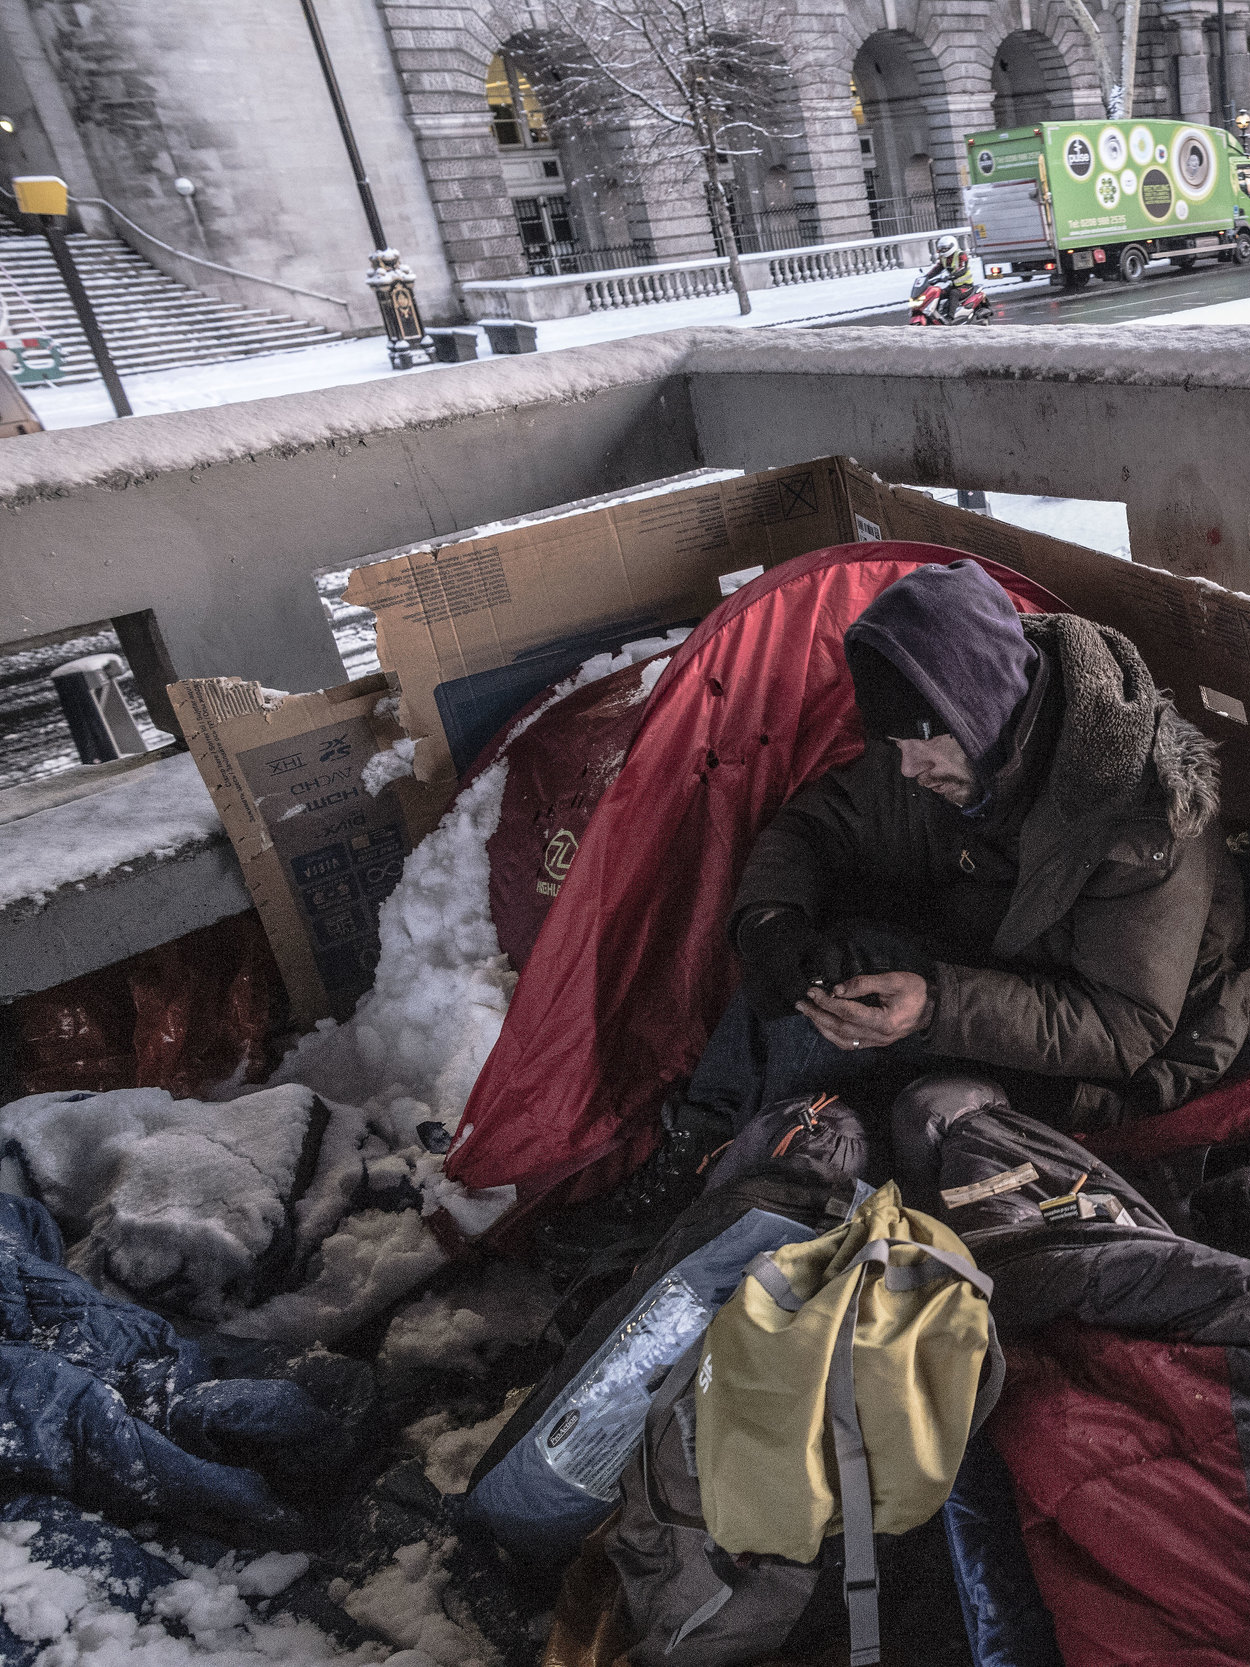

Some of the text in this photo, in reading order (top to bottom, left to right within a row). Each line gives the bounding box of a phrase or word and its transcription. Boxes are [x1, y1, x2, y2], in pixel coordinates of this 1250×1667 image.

[1068, 153, 1090, 165] pulse
[267, 754, 307, 774] THX
[288, 767, 353, 796] AVCHD
